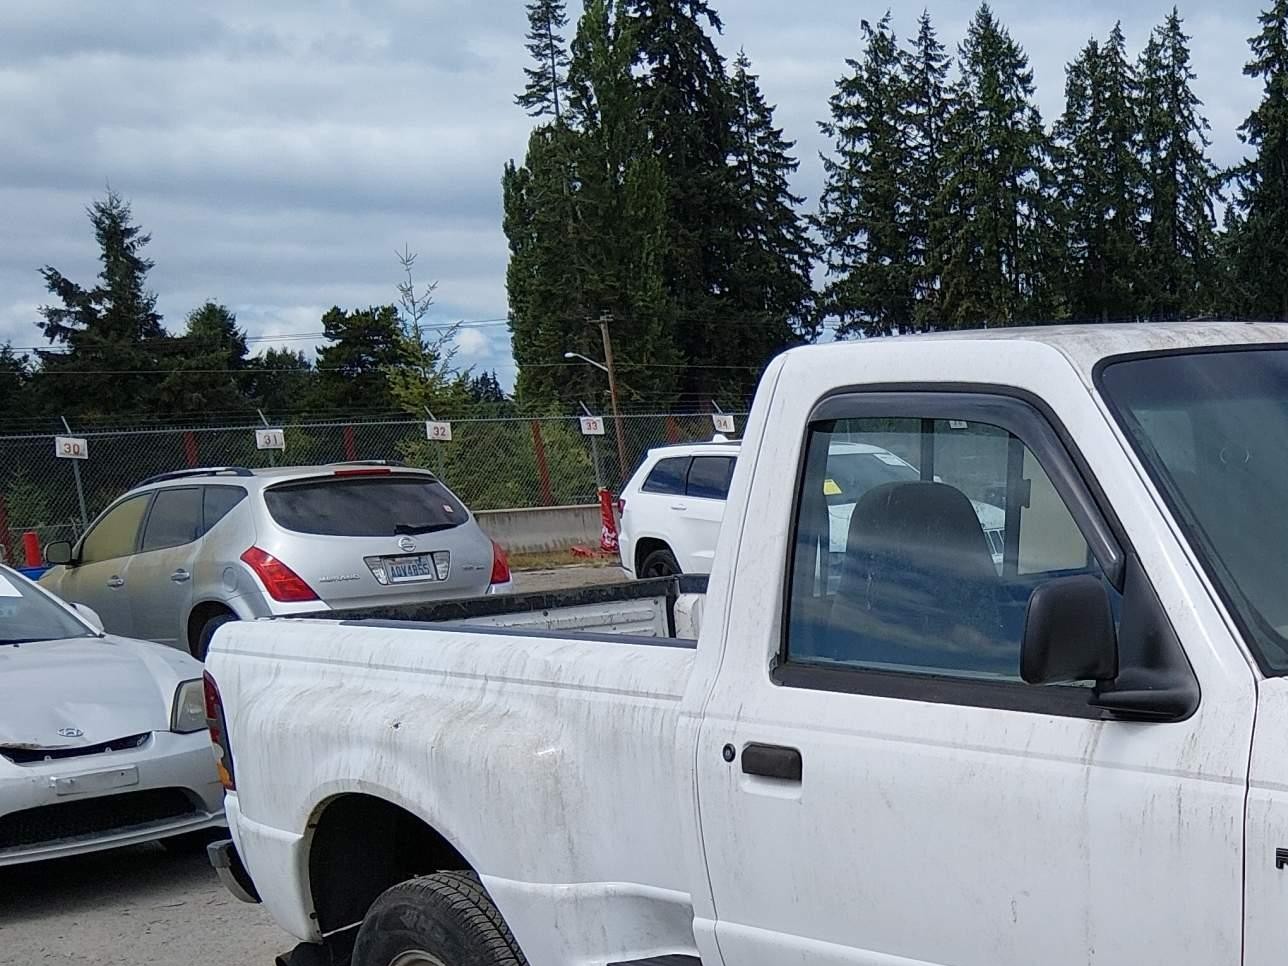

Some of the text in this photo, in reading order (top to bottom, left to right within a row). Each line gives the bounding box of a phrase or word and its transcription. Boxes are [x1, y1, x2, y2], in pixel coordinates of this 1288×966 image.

[433, 426, 446, 437] 32
[585, 421, 598, 431] 33
[263, 434, 278, 445] 31
[63, 443, 80, 455] 30
